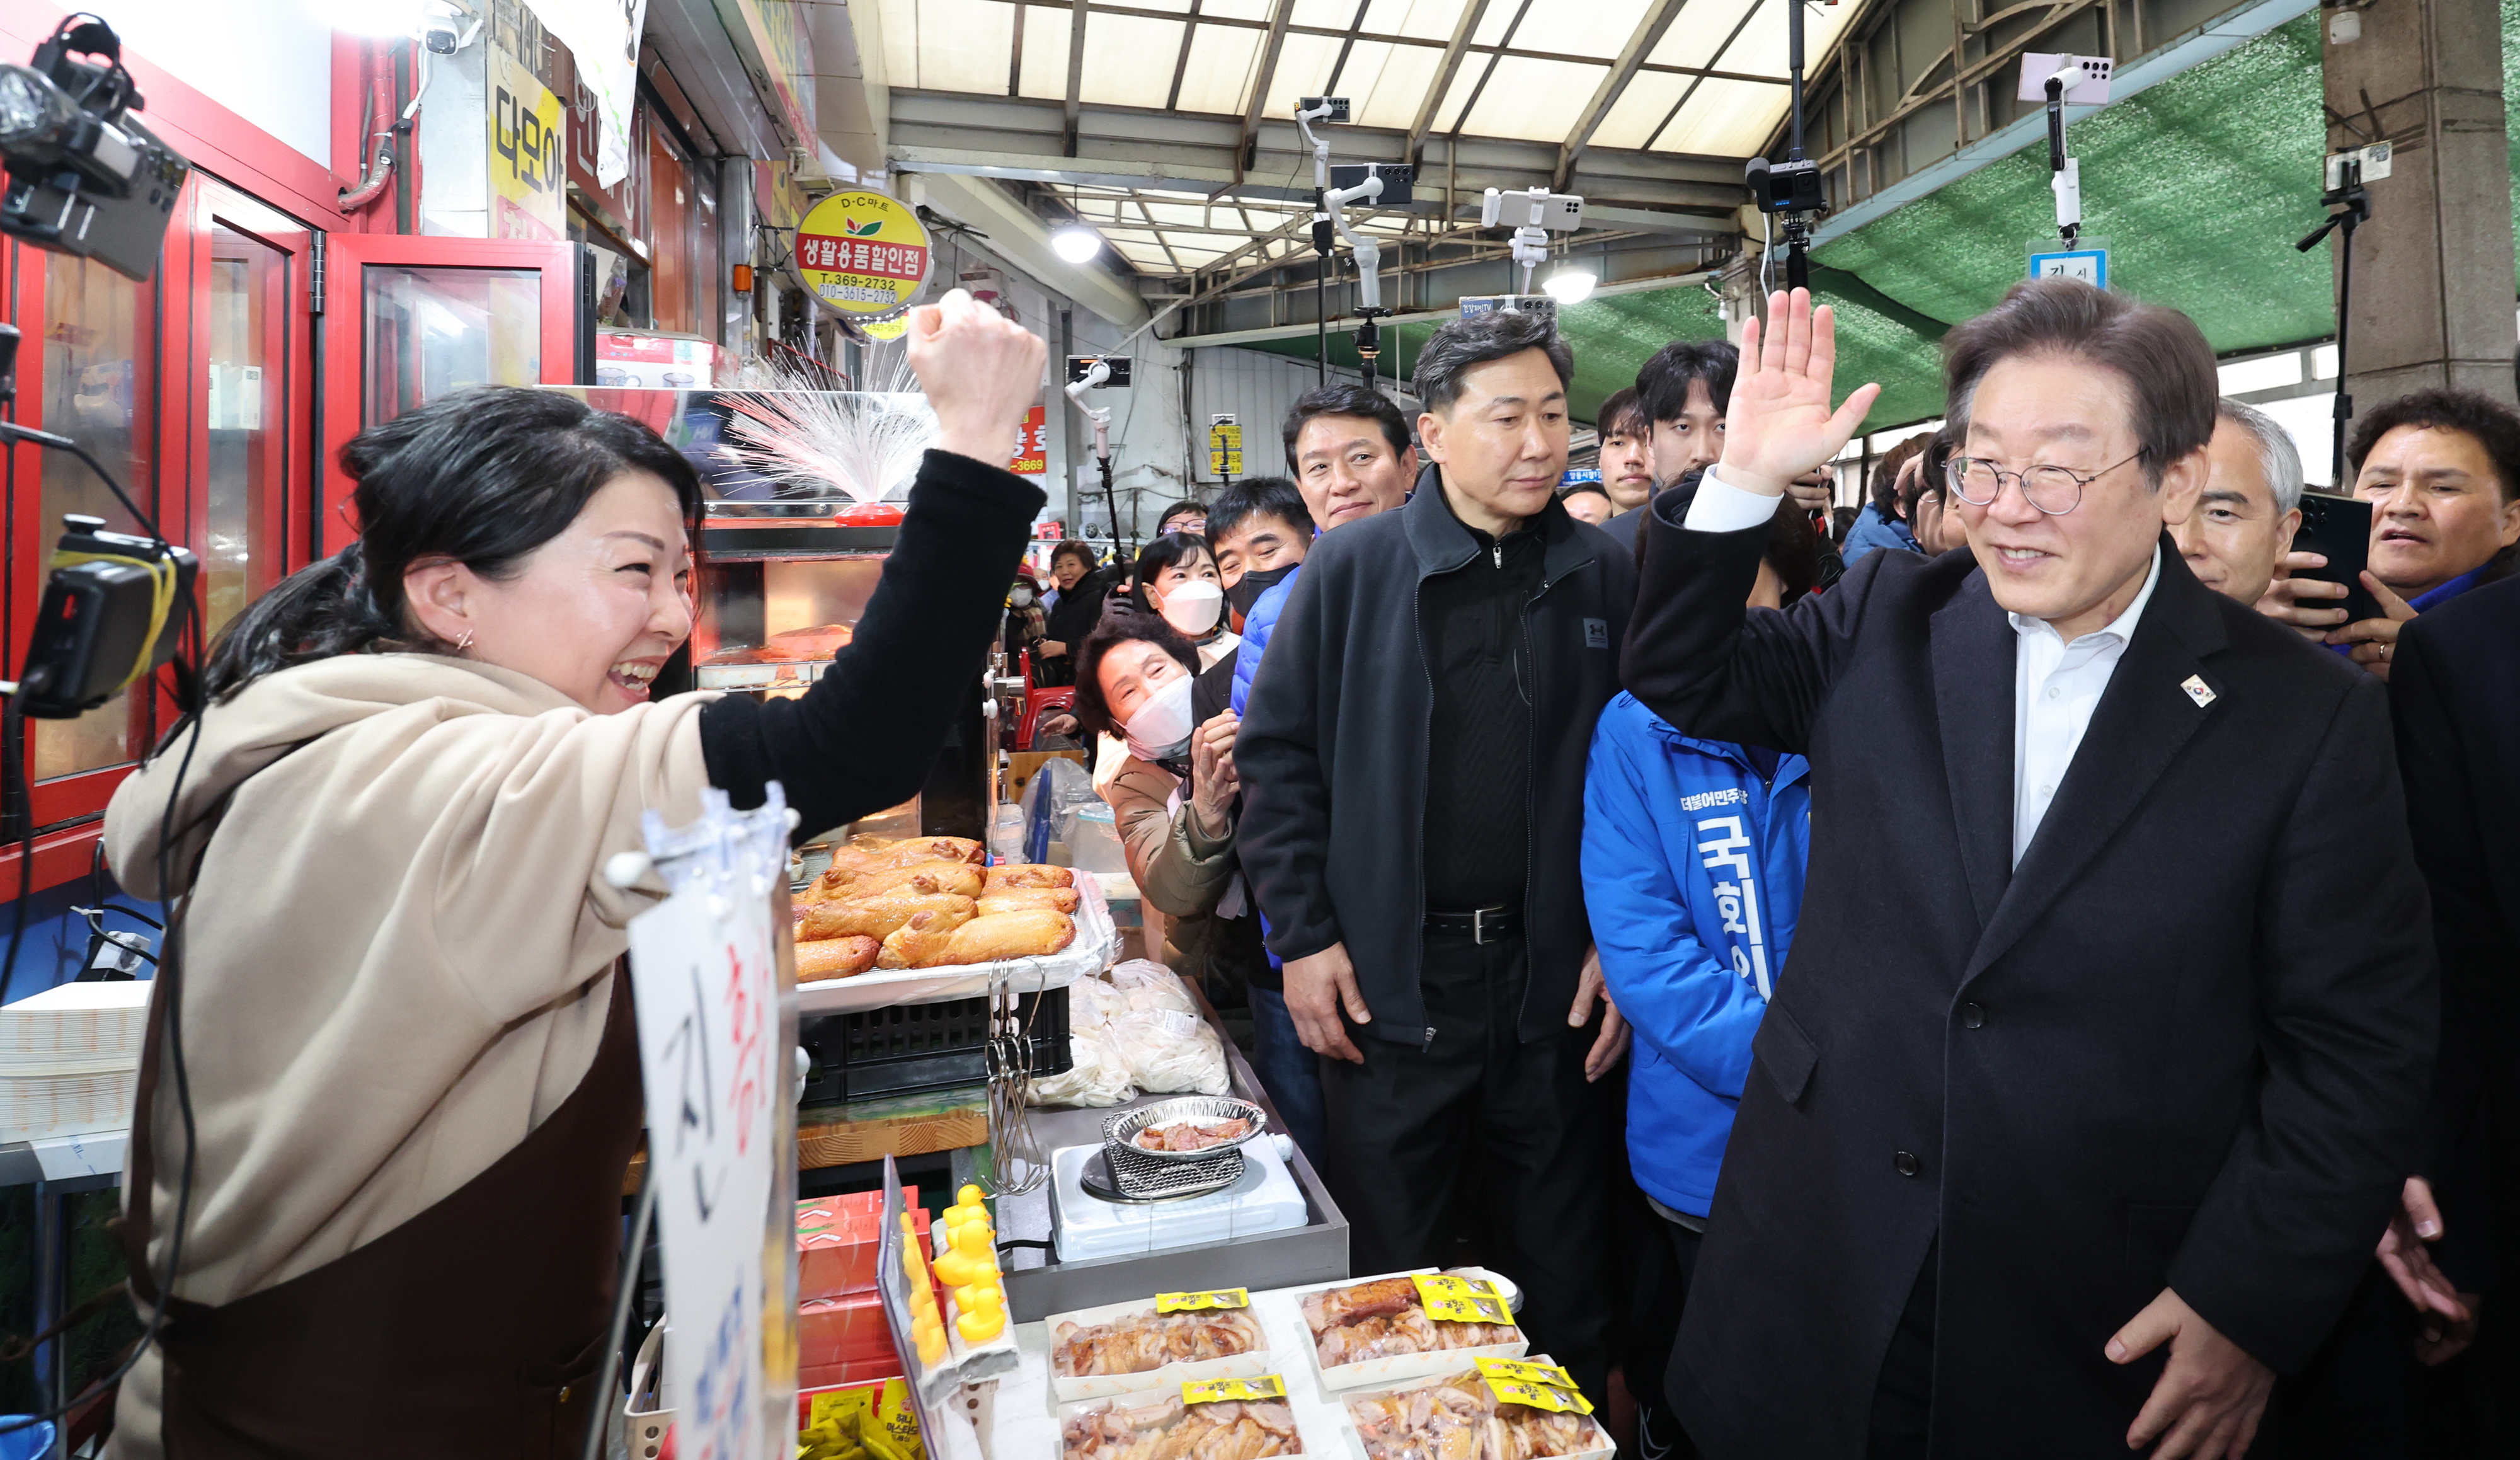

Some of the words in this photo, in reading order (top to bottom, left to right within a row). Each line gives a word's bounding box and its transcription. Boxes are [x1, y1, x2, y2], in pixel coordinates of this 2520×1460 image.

[496, 84, 564, 212] 다모아
[803, 239, 920, 276] 생활용품할인점
[820, 273, 896, 290] T.369-2732
[819, 284, 896, 304] 010-3615-2732
[1680, 788, 1748, 812] 더불어민주당
